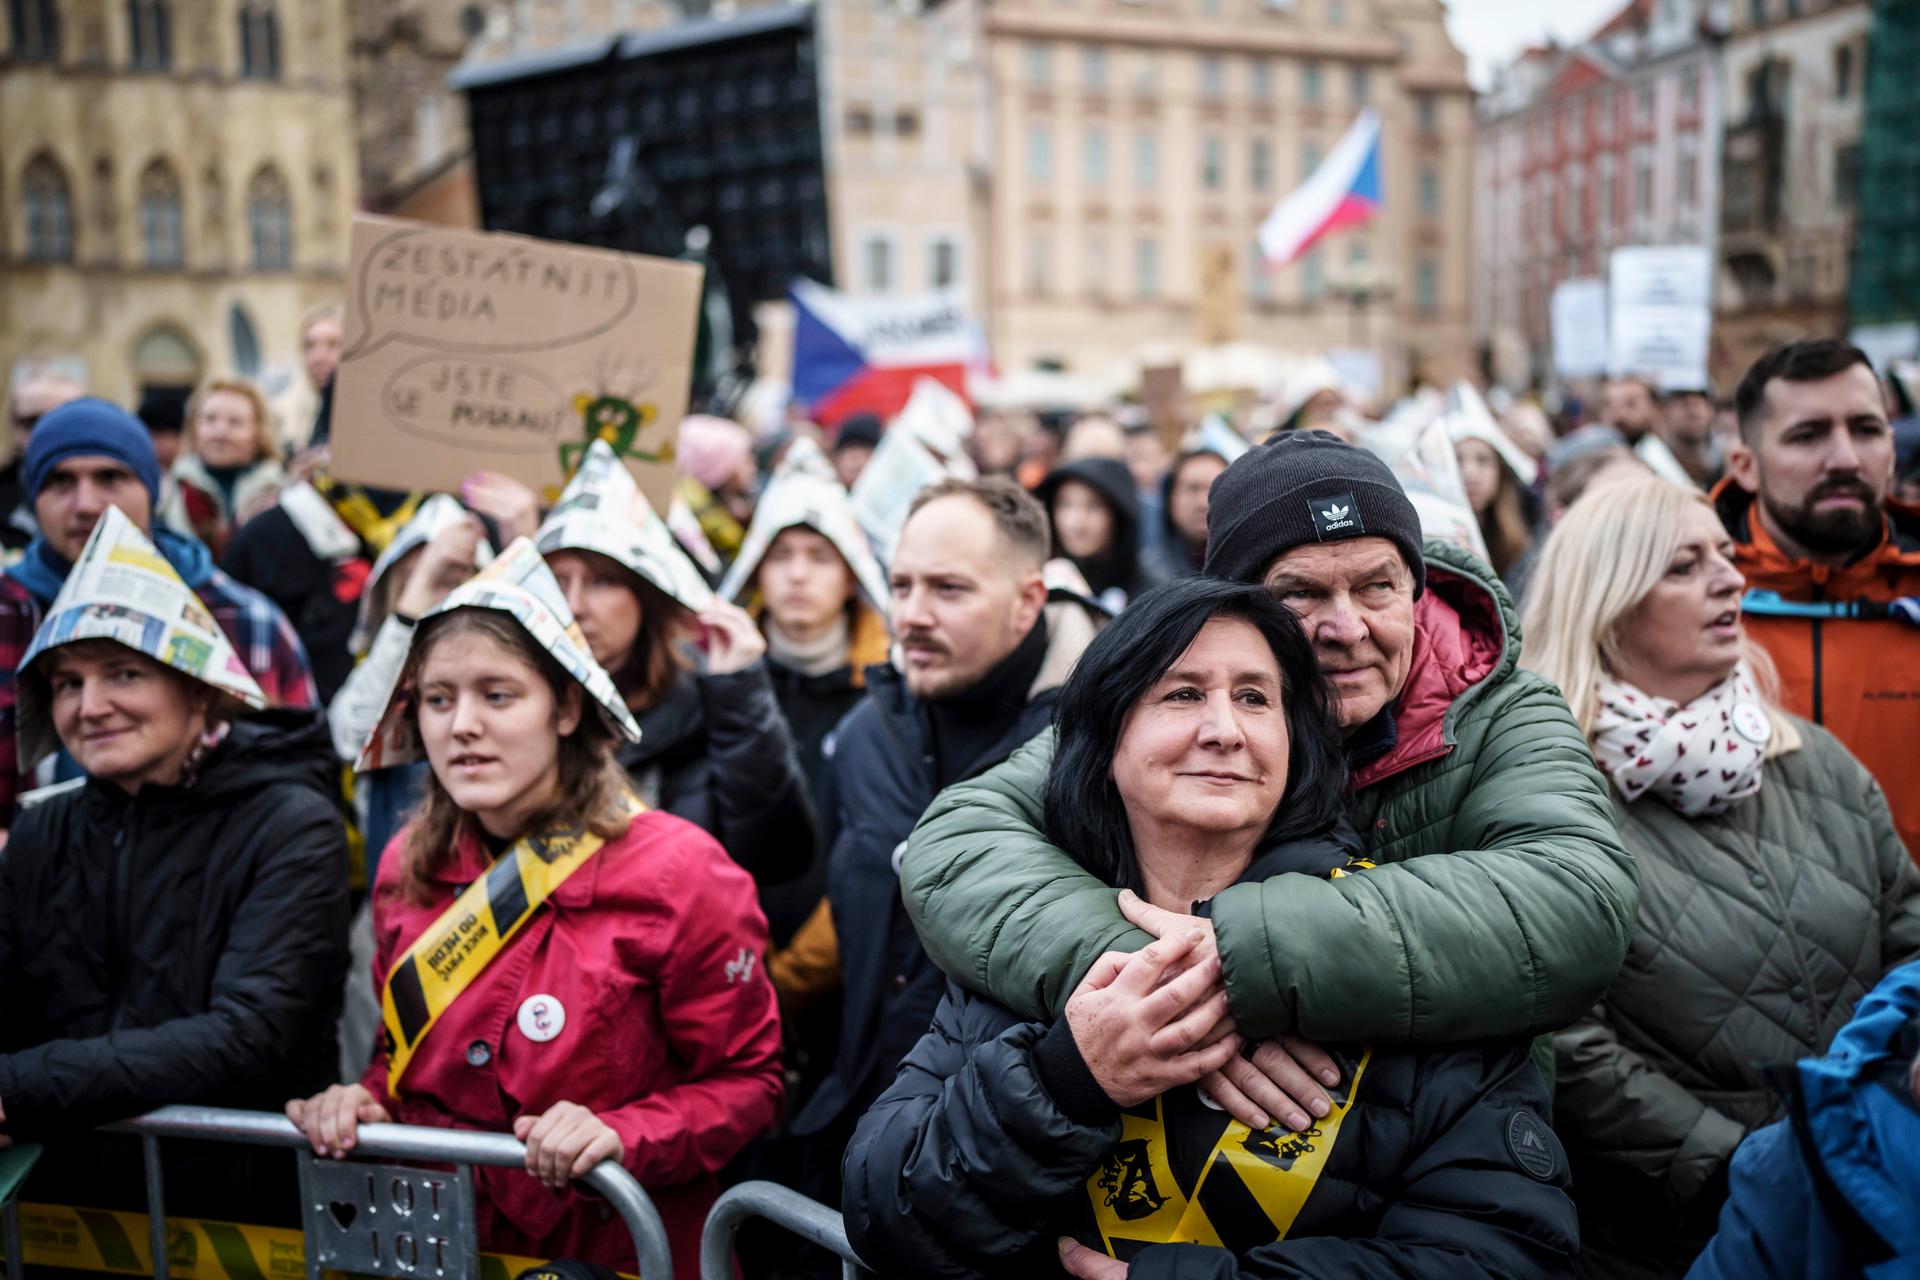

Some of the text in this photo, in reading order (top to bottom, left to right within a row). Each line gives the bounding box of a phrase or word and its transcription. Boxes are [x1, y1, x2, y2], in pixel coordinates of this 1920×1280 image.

[383, 243, 618, 298] ZESTÁTNIT
[373, 276, 496, 324] MÉDIA
[431, 364, 515, 400] JSTE
[1326, 520, 1353, 531] adidas
[459, 913, 478, 934] OD
